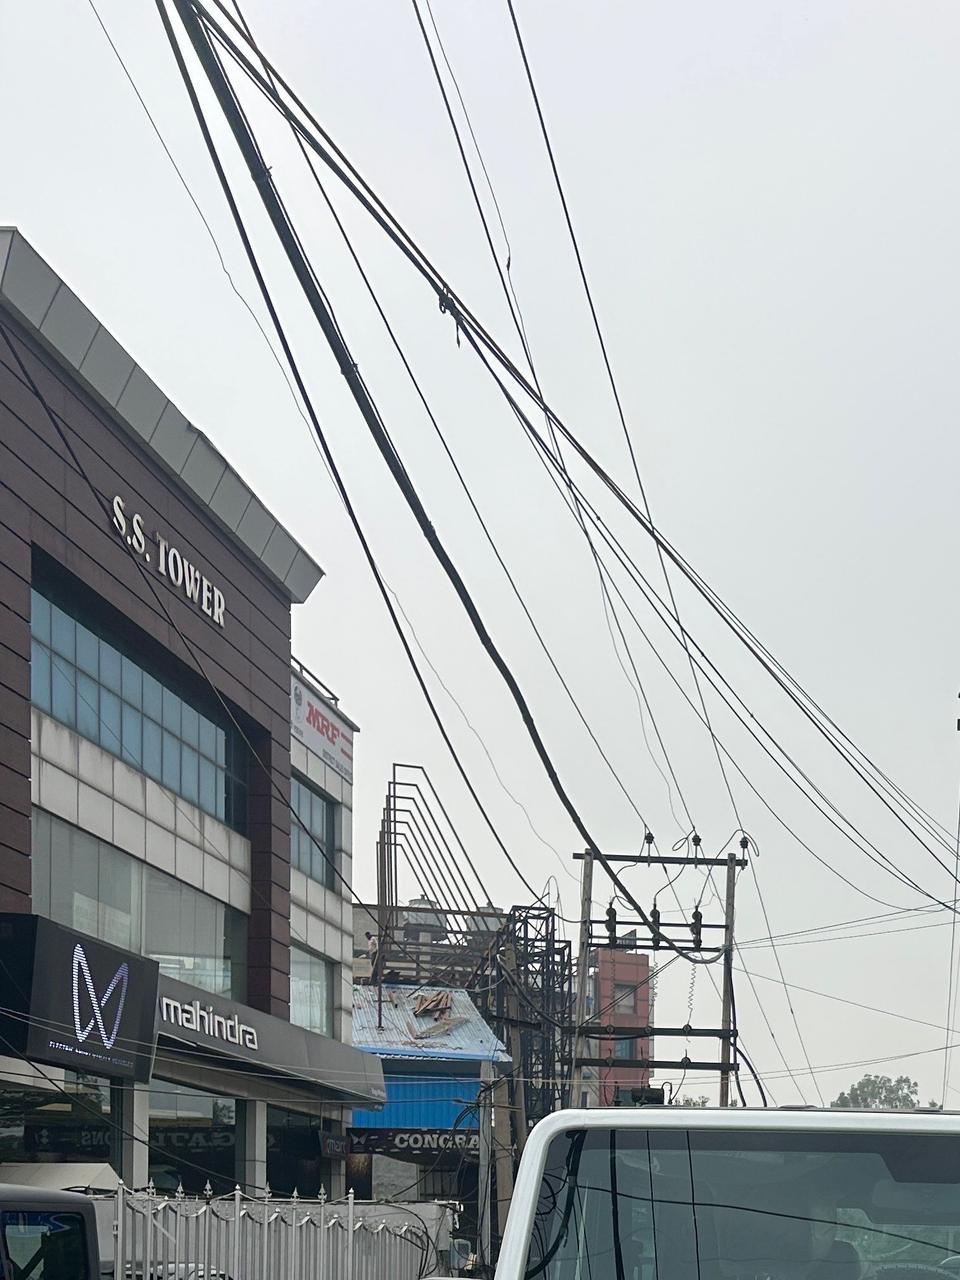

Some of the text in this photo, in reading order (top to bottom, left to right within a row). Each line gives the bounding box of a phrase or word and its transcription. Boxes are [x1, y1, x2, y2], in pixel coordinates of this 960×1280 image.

[112, 495, 225, 629] S.S. TOWER
[306, 701, 340, 746] MRF
